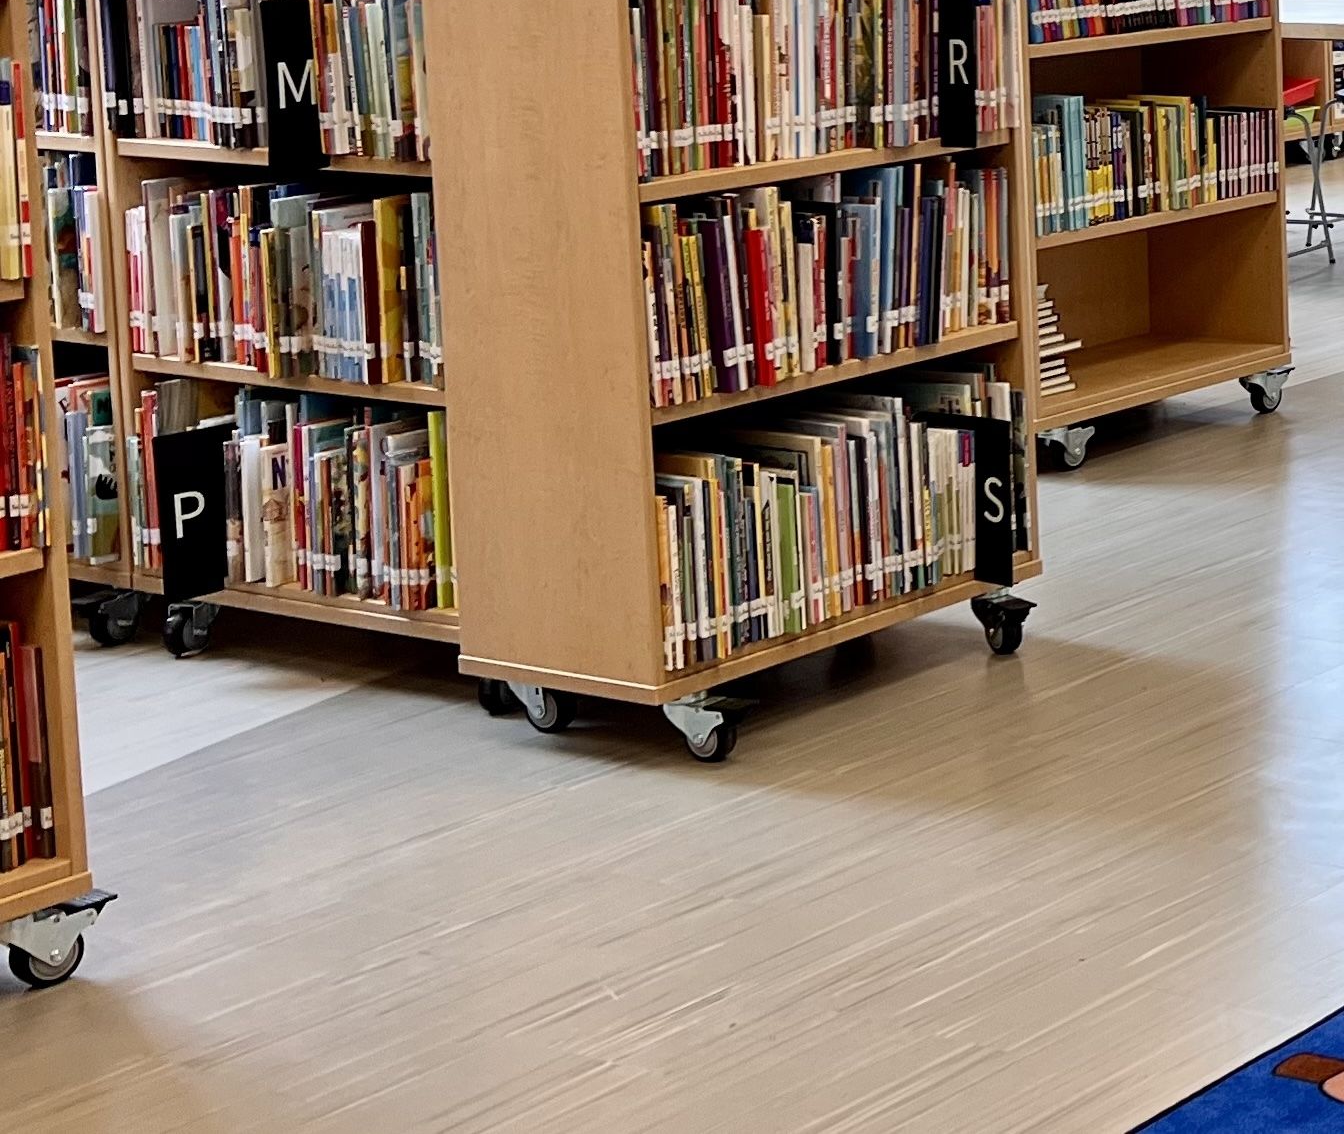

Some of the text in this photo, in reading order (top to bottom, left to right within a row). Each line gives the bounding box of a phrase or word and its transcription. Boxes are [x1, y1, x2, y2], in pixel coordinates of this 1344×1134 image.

[277, 59, 318, 110] M
[948, 38, 970, 85] R
[173, 490, 206, 540] P
[983, 476, 1005, 523] S
